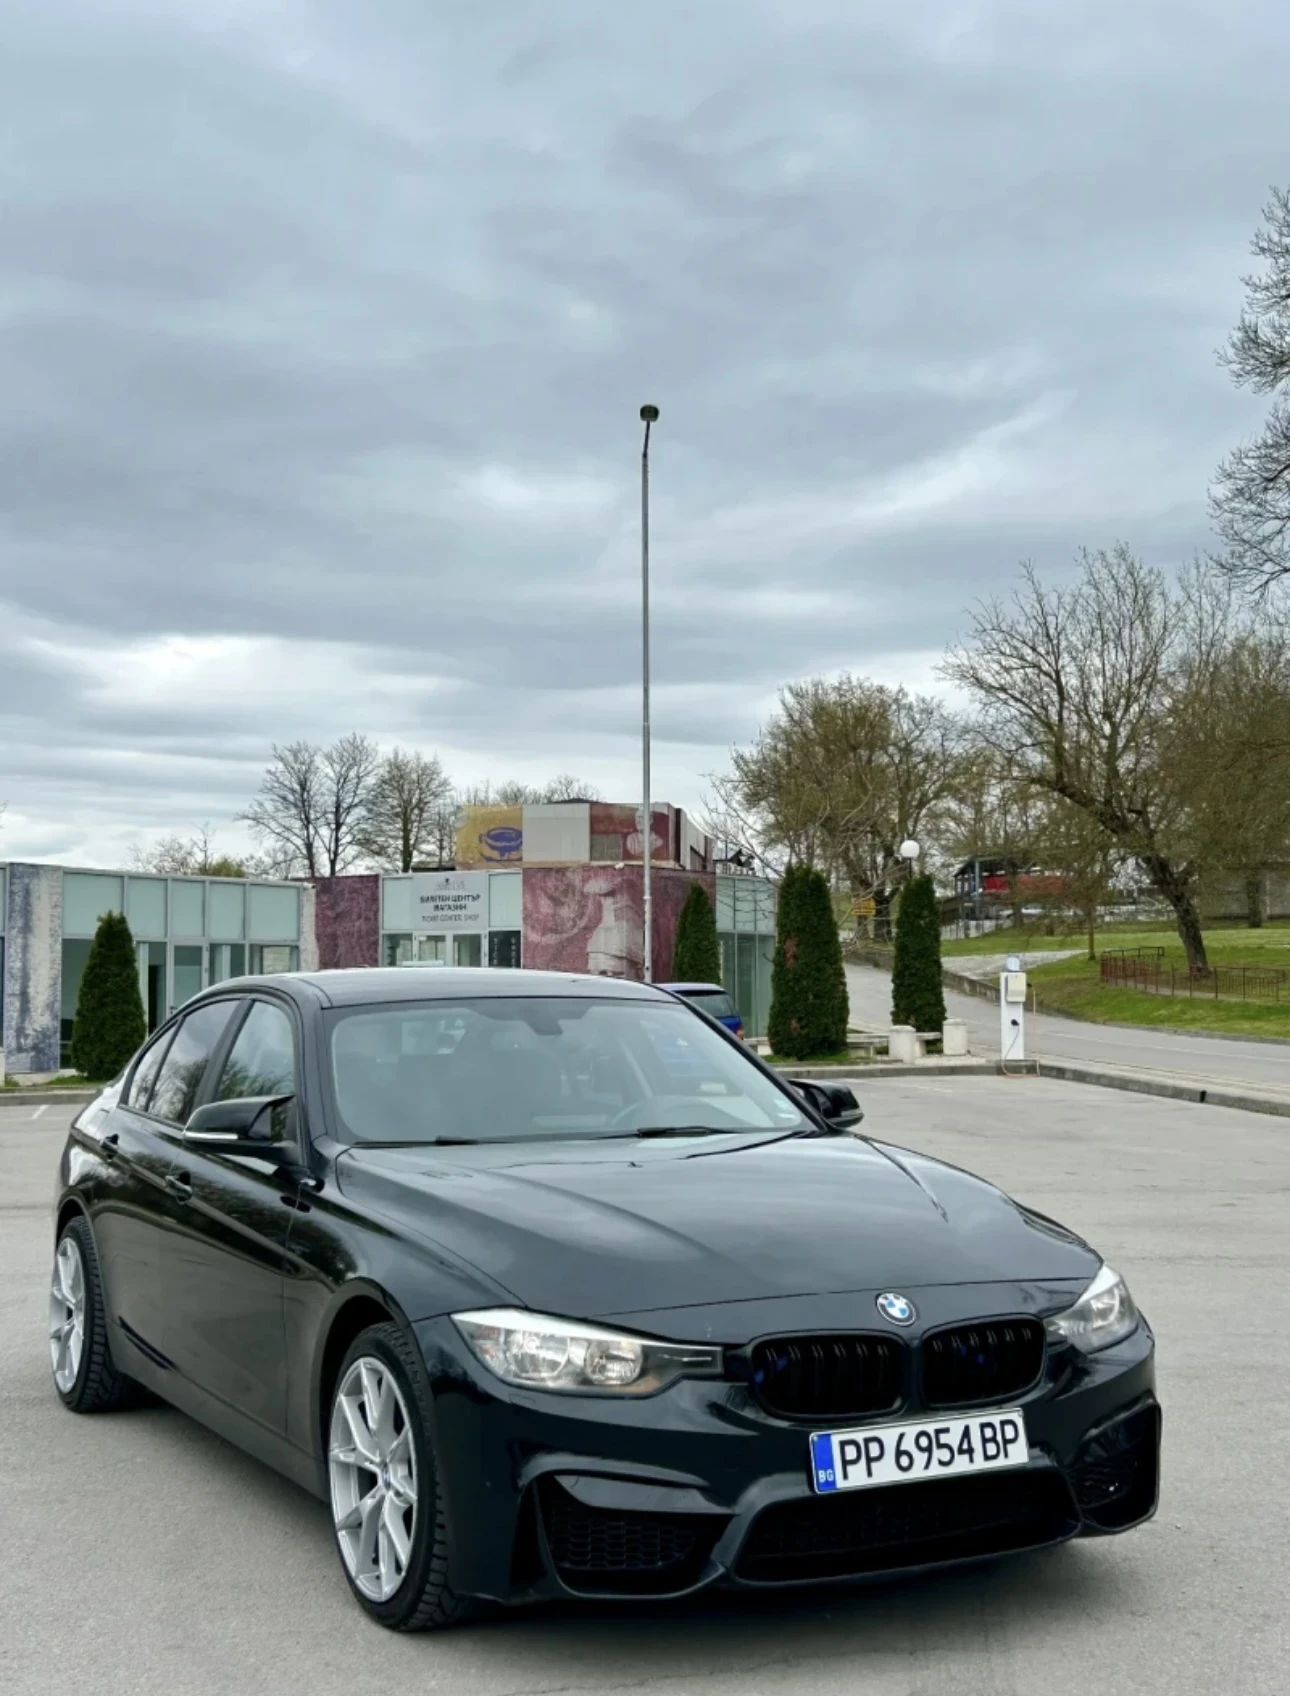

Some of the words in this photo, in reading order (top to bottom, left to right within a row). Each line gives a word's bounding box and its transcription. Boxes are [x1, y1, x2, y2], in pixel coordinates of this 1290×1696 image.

[451, 893, 481, 903] ЦЕНТЪР
[433, 903, 467, 912] МАГАЗИН
[839, 1436, 885, 1480] PP
[894, 1424, 975, 1473] 6954
[979, 1418, 1020, 1462] BP
[818, 1469, 835, 1483] BG
